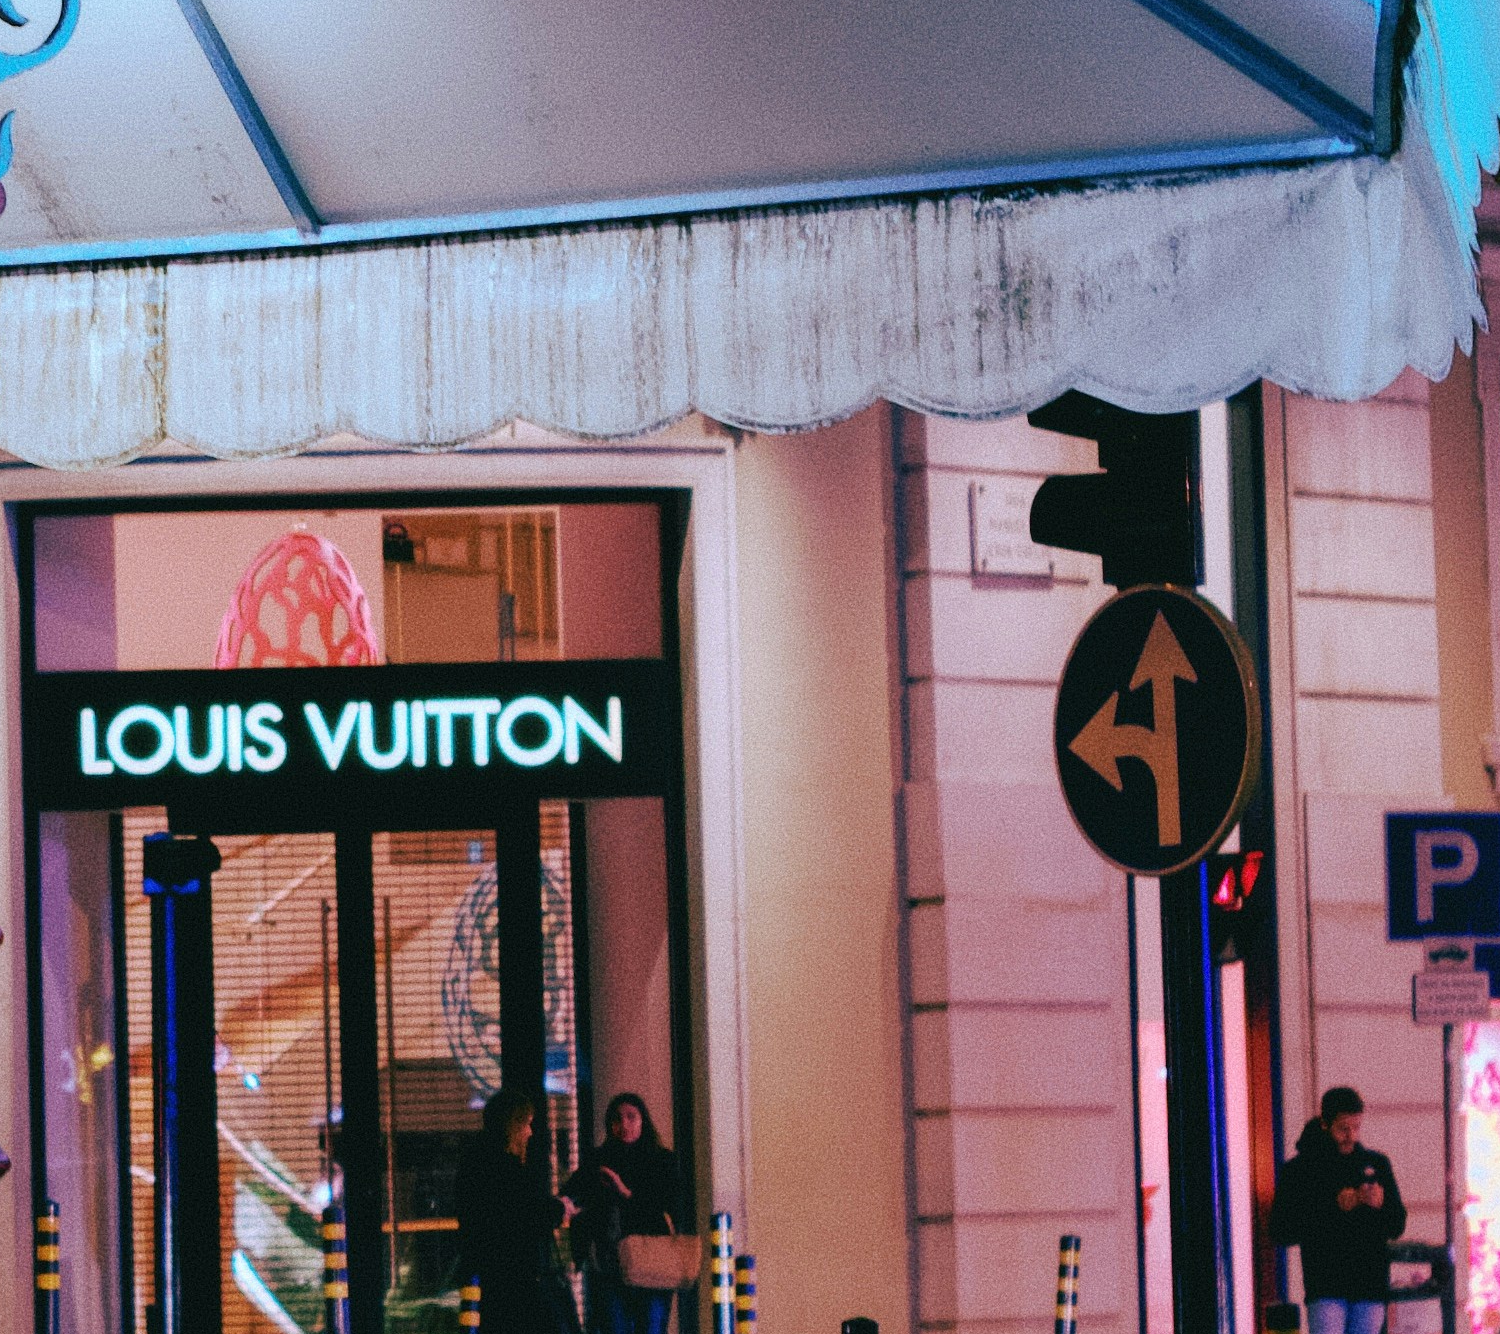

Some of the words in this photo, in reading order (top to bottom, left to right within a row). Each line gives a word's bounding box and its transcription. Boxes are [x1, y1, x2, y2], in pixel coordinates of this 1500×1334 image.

[78, 701, 288, 778] LOUIS
[303, 694, 625, 772] VUITTON
[1415, 829, 1479, 923] P
